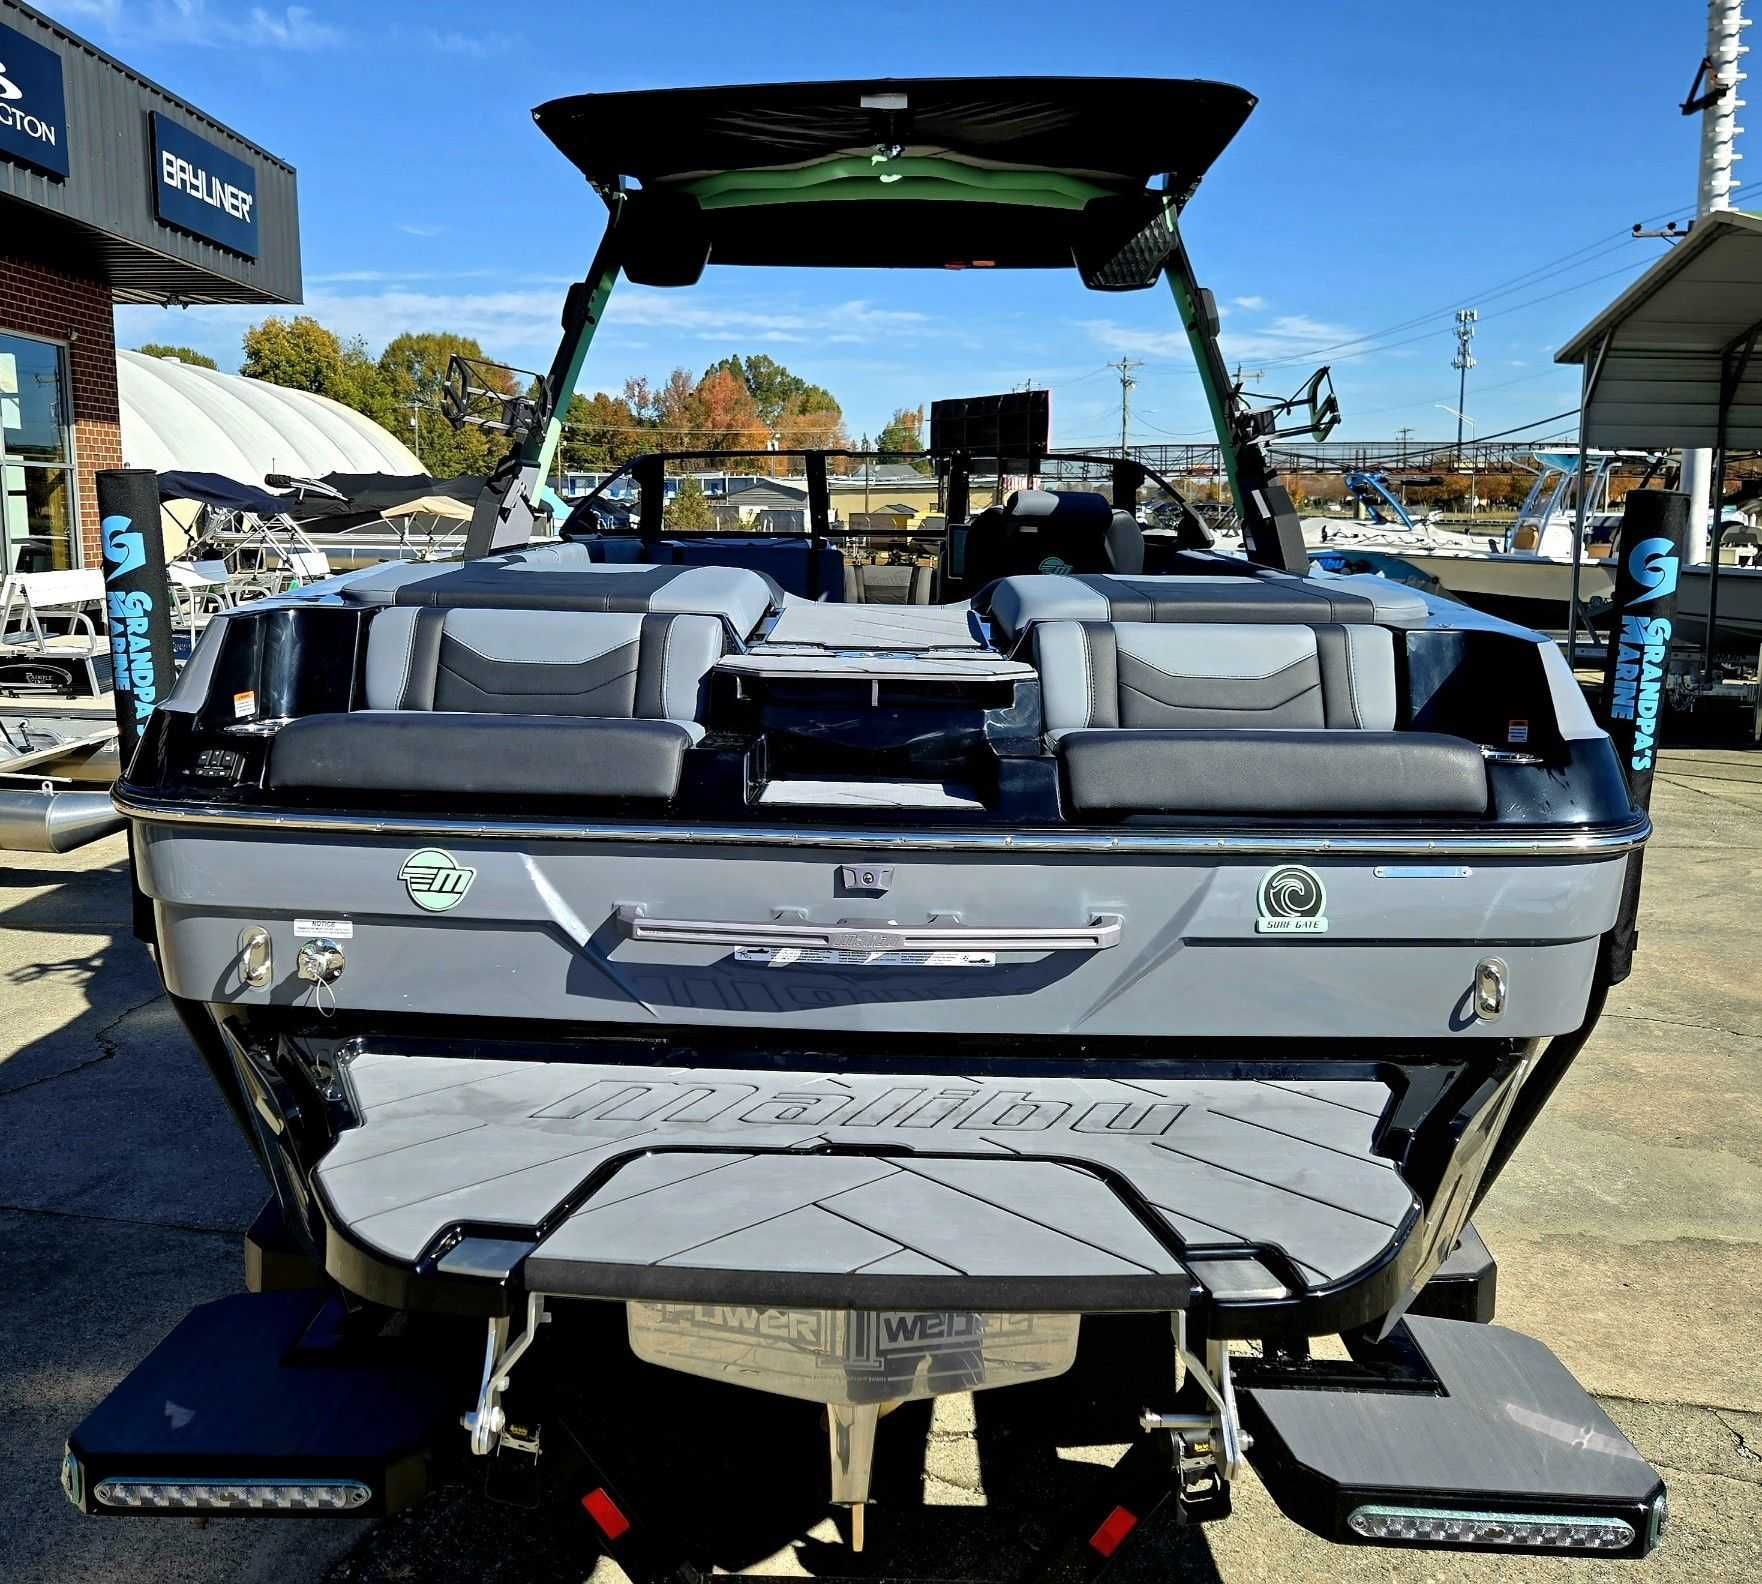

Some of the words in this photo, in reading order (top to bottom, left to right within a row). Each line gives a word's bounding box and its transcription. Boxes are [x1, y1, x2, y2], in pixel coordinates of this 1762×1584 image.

[162, 150, 251, 223] BAYLINER
[107, 591, 131, 691] MARINE
[124, 591, 157, 737] GRANDPA
[1611, 616, 1648, 720] MARINE
[1631, 617, 1672, 771] GRANDPA'S
[1267, 920, 1290, 929] SURF
[1295, 920, 1320, 929] GATE
